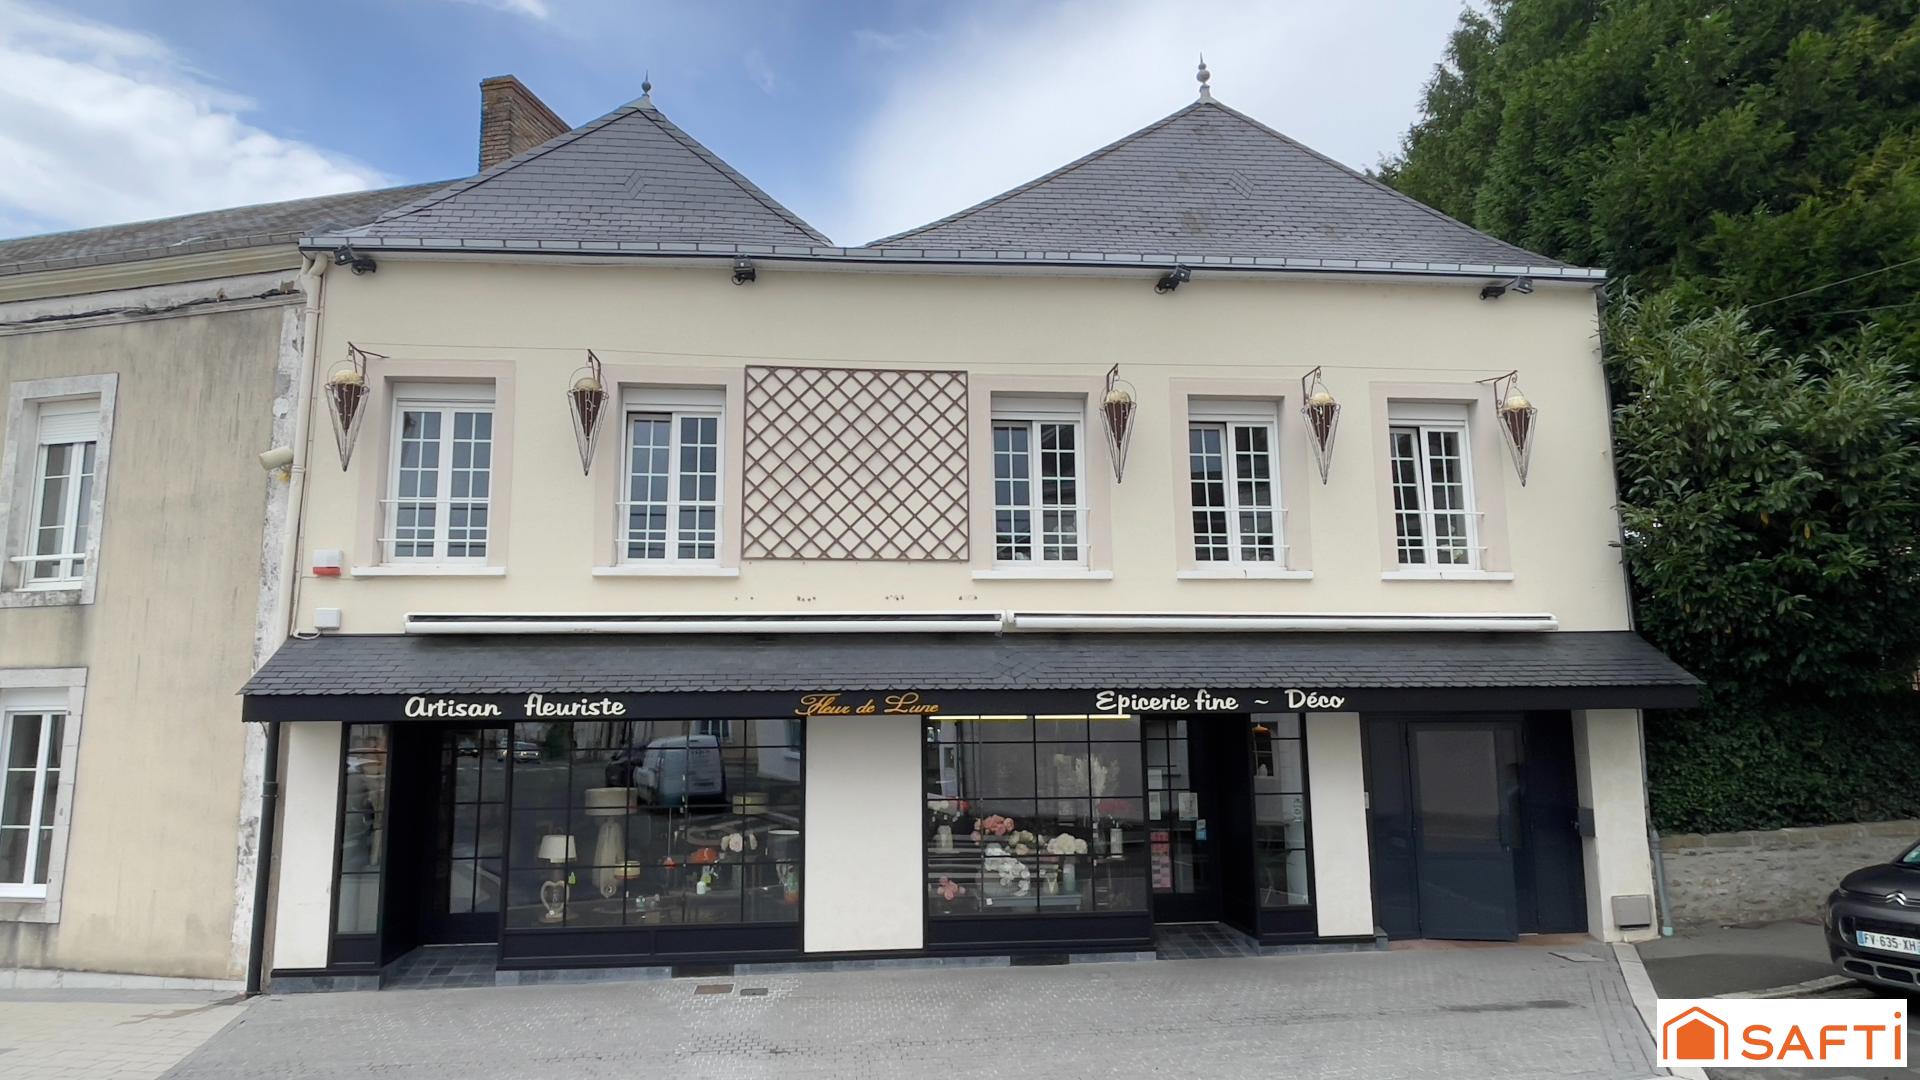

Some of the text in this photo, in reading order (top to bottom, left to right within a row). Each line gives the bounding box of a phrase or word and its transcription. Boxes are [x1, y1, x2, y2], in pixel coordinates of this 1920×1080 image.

[404, 693, 626, 717] Artisan fleuriste
[795, 692, 939, 716] Fleur de Lune
[1095, 689, 1190, 714] Epicerie
[1194, 689, 1239, 711] fine
[1284, 688, 1345, 709] Déco
